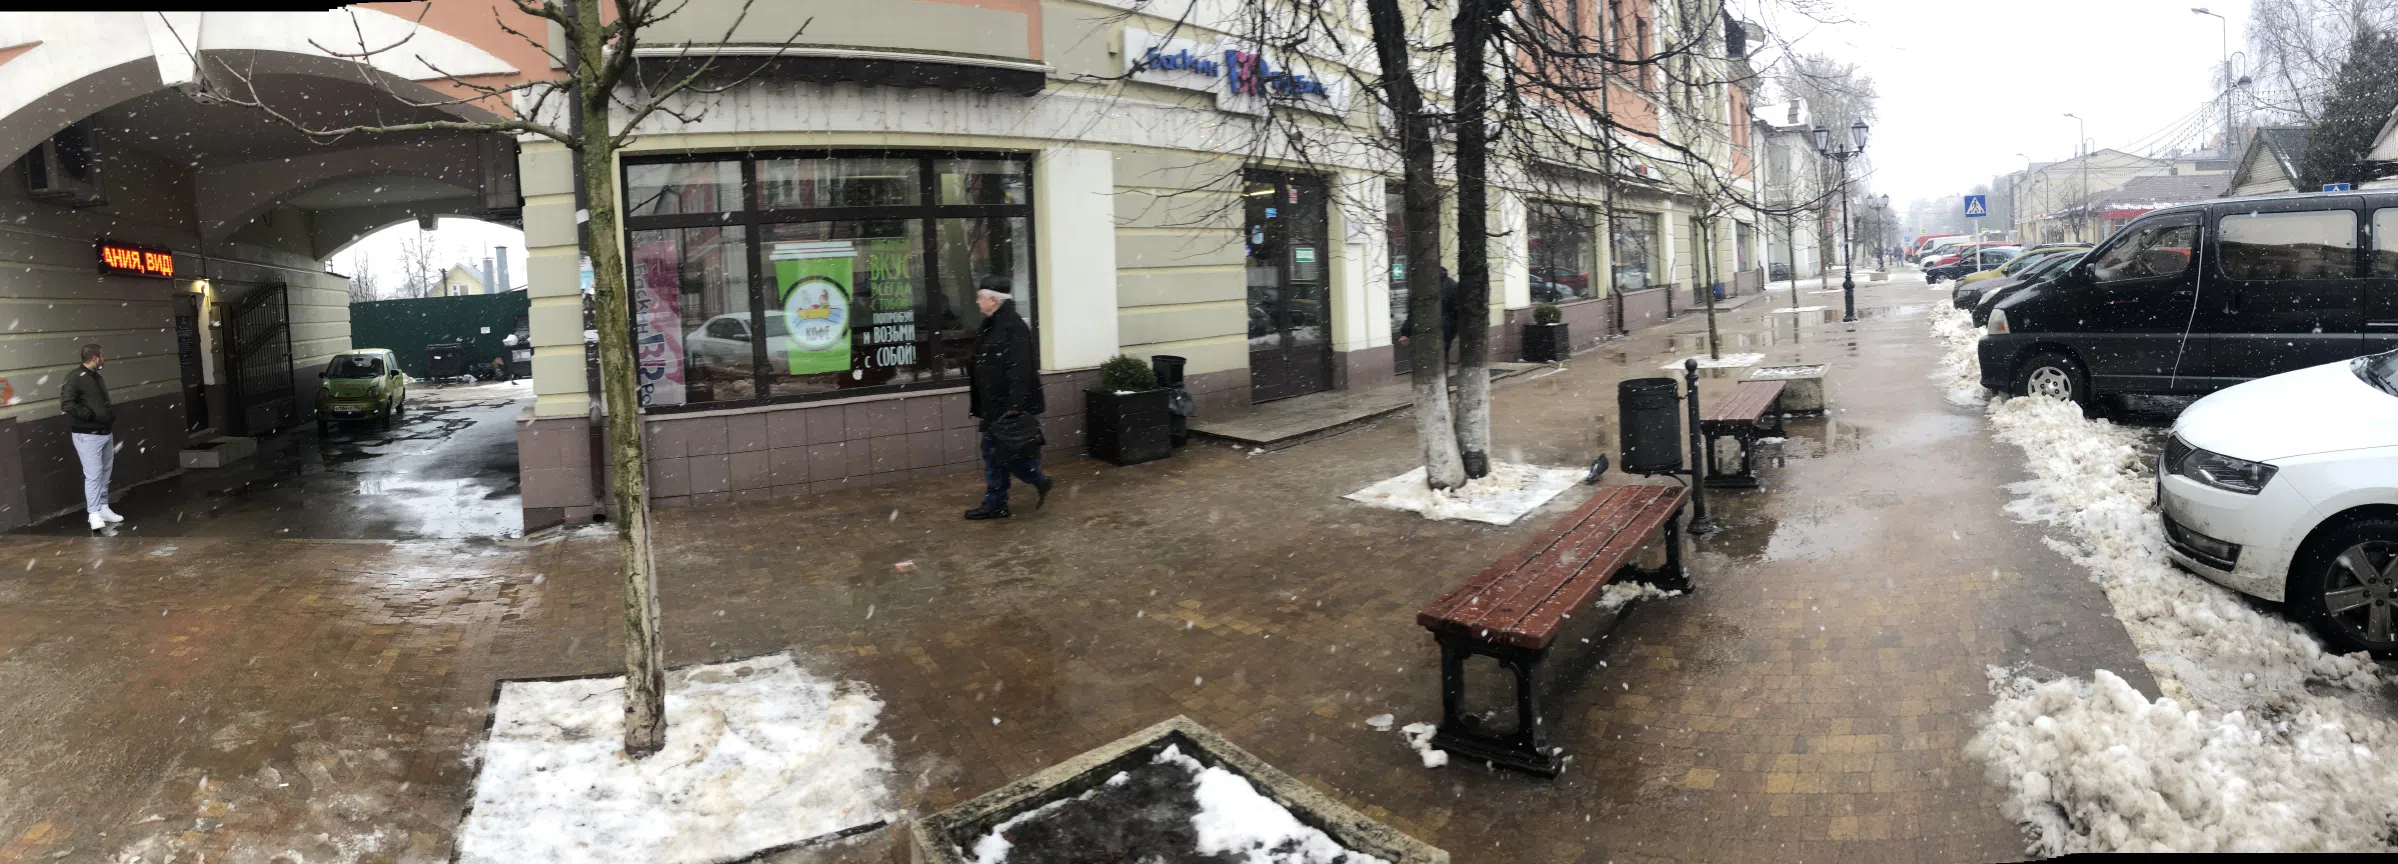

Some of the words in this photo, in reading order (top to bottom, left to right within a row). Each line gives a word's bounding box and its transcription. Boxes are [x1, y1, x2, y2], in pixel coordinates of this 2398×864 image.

[103, 246, 145, 274] АНИЯ,
[145, 252, 173, 276] ВИД
[873, 324, 915, 343] ВОЗЬМИ
[876, 342, 917, 367] СОБОЙ!
